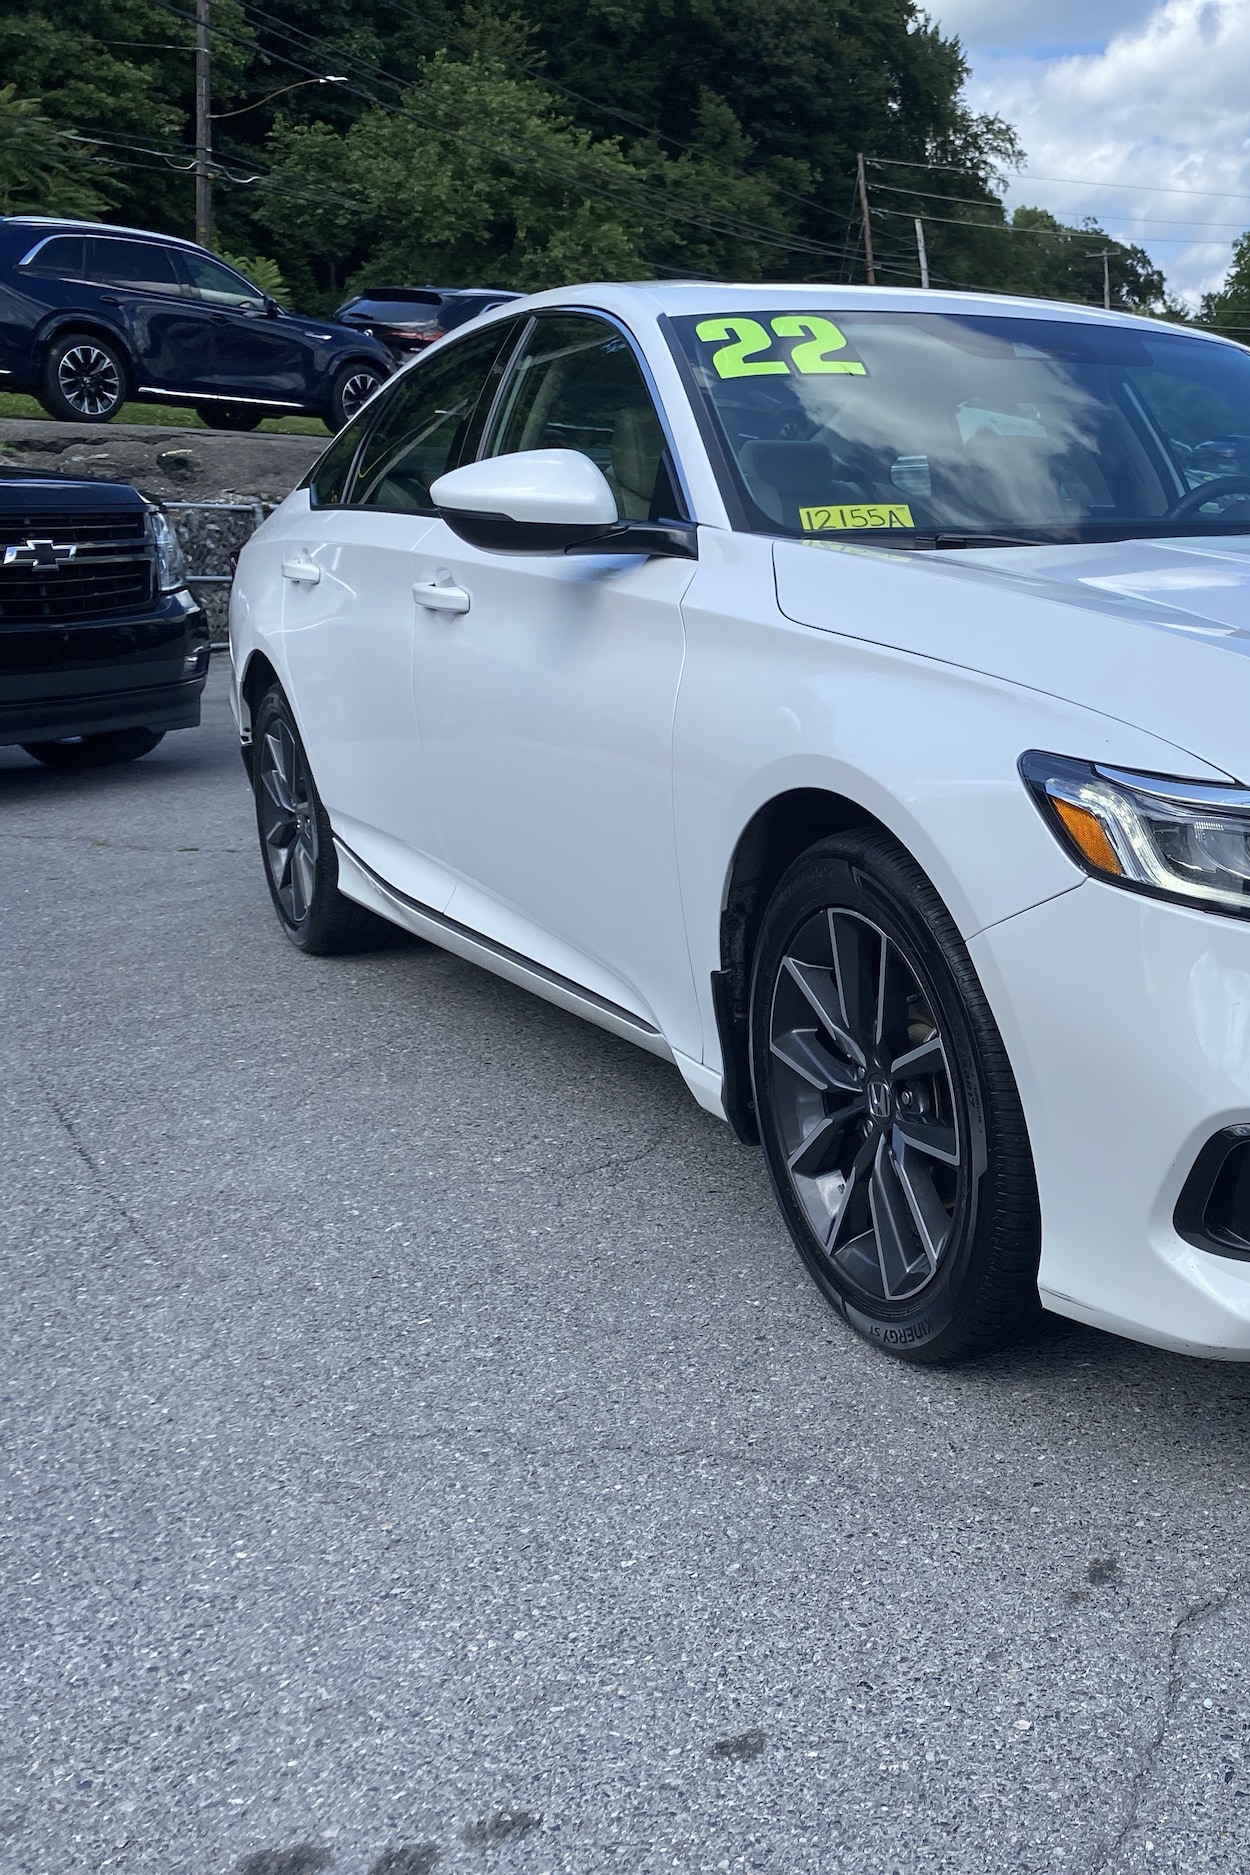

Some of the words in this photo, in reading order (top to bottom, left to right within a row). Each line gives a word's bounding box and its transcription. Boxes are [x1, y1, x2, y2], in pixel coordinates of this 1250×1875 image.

[695, 315, 867, 380] 22
[805, 507, 908, 531] 12155A
[869, 1325, 881, 1337] ST
